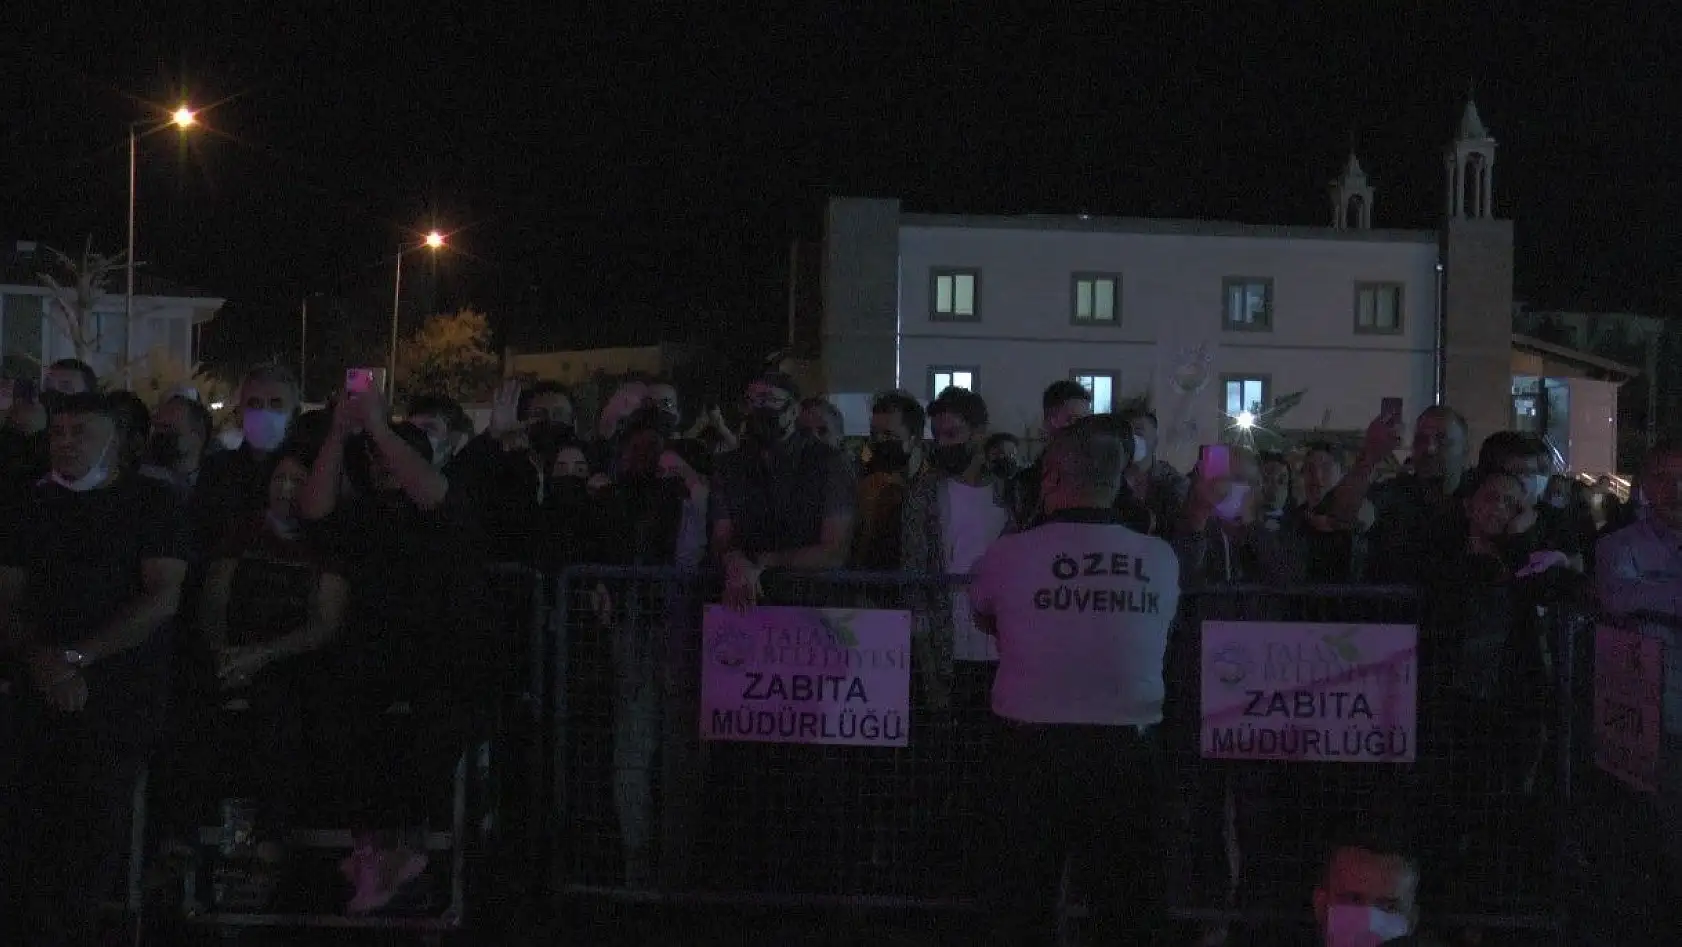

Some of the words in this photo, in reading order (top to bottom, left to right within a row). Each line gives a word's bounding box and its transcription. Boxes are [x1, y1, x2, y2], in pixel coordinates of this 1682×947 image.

[1052, 552, 1150, 583] ÖZEL
[1033, 586, 1160, 614] GÜVENLİK
[742, 672, 868, 704] ZABITA
[1243, 690, 1373, 719] ZABITA
[711, 704, 903, 740] MÜDÜRLÜĞÜ
[1212, 723, 1408, 756] MÜDÜRLÜĞÜ
